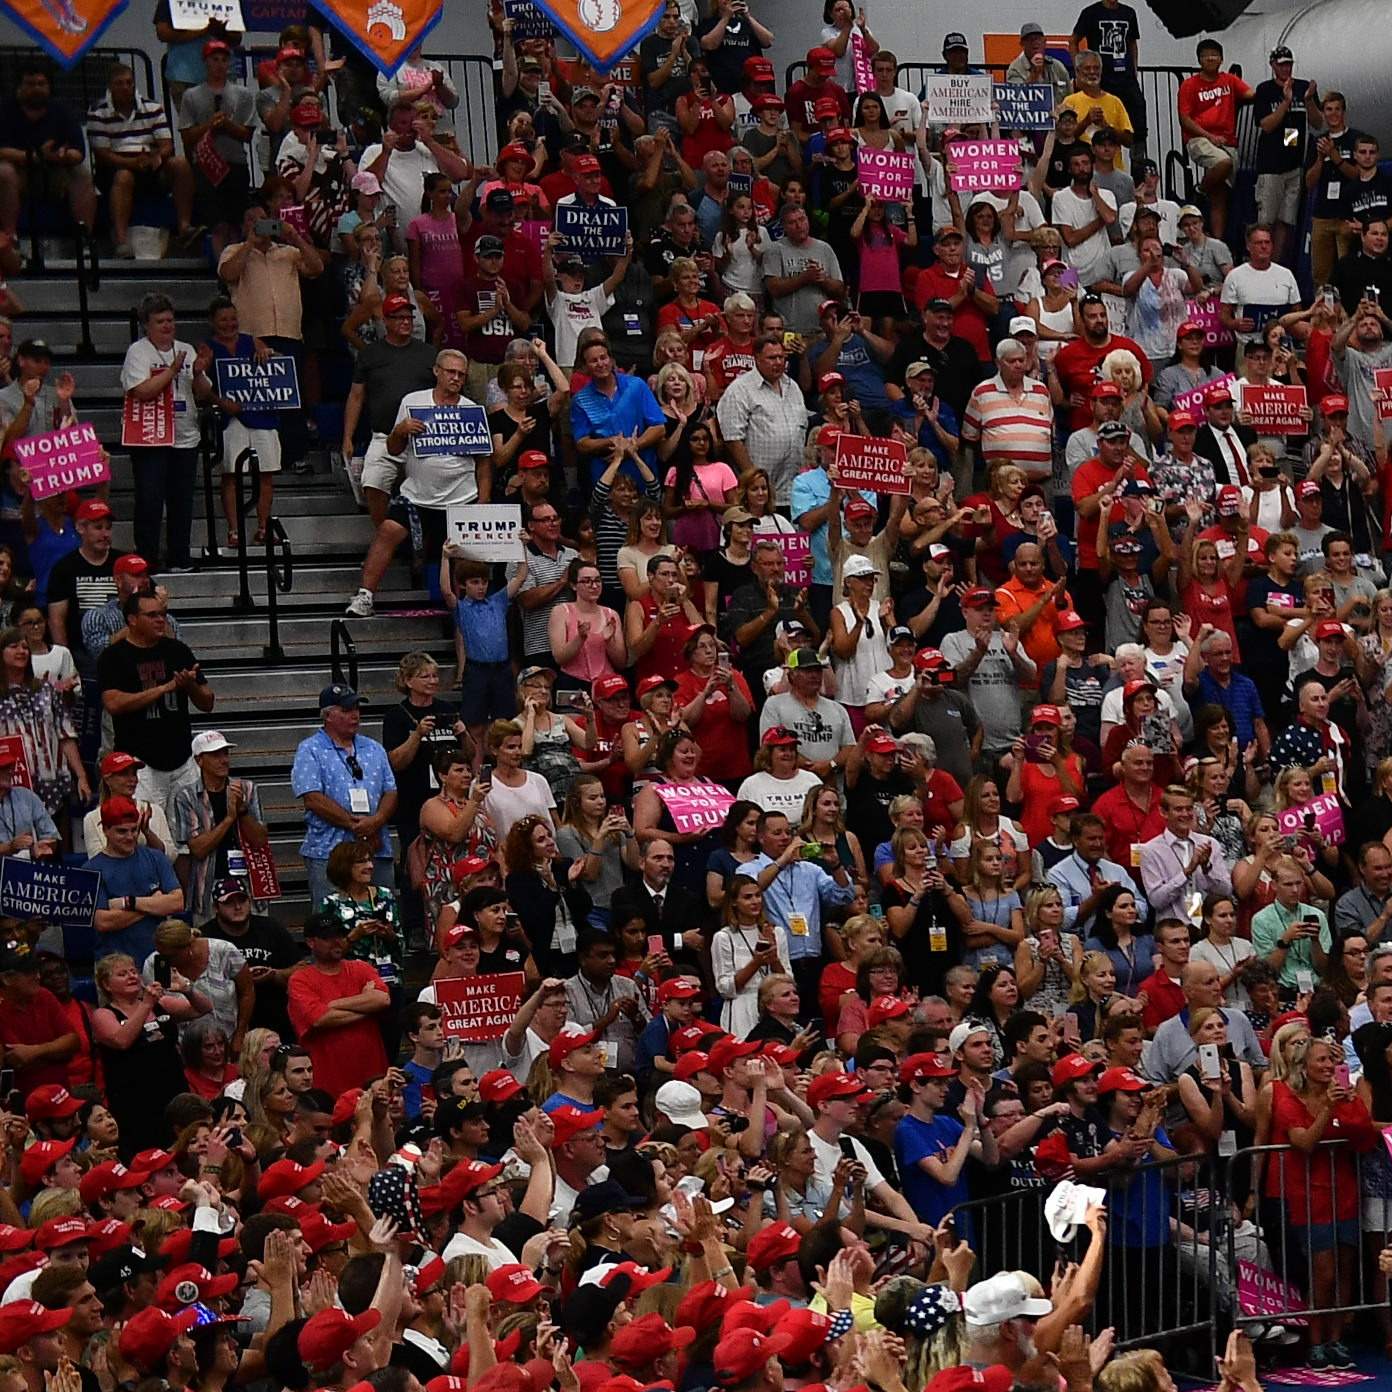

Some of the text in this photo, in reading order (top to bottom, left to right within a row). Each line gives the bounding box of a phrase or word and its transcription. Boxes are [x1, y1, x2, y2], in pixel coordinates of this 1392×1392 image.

[950, 79, 970, 88] BUY
[995, 88, 1044, 101] DRAIN
[950, 98, 971, 107] HIRE
[1011, 101, 1030, 111] THE
[952, 144, 1019, 158] WOMEN
[859, 152, 914, 168] WOMEN
[973, 161, 997, 170] FOR
[878, 171, 902, 181] FOR
[955, 174, 1016, 186] TRUMP
[565, 211, 620, 226] DRAIN
[583, 226, 603, 236] THE
[562, 236, 622, 248] SWAMP
[227, 361, 286, 378] DRAIN
[246, 378, 270, 388] THE
[226, 387, 293, 403] SWAMP
[1264, 392, 1286, 400] MAKE
[434, 411, 461, 420] MAKE
[1275, 416, 1301, 425] AGAIN
[18, 426, 97, 457] WOMEN
[415, 434, 488, 447] STRONG AGAIN
[864, 444, 889, 455] MAKE
[49, 452, 78, 468] FOR
[34, 463, 104, 491] TRUMP
[842, 469, 905, 485] GREAT AGAIN
[455, 521, 517, 532] TRUMP
[33, 870, 66, 885] MAKE
[2, 881, 94, 905] AMERICA
[2, 896, 93, 917] STRONG AGAIN
[465, 984, 496, 996] MAKE
[447, 1014, 479, 1029] GREAT
